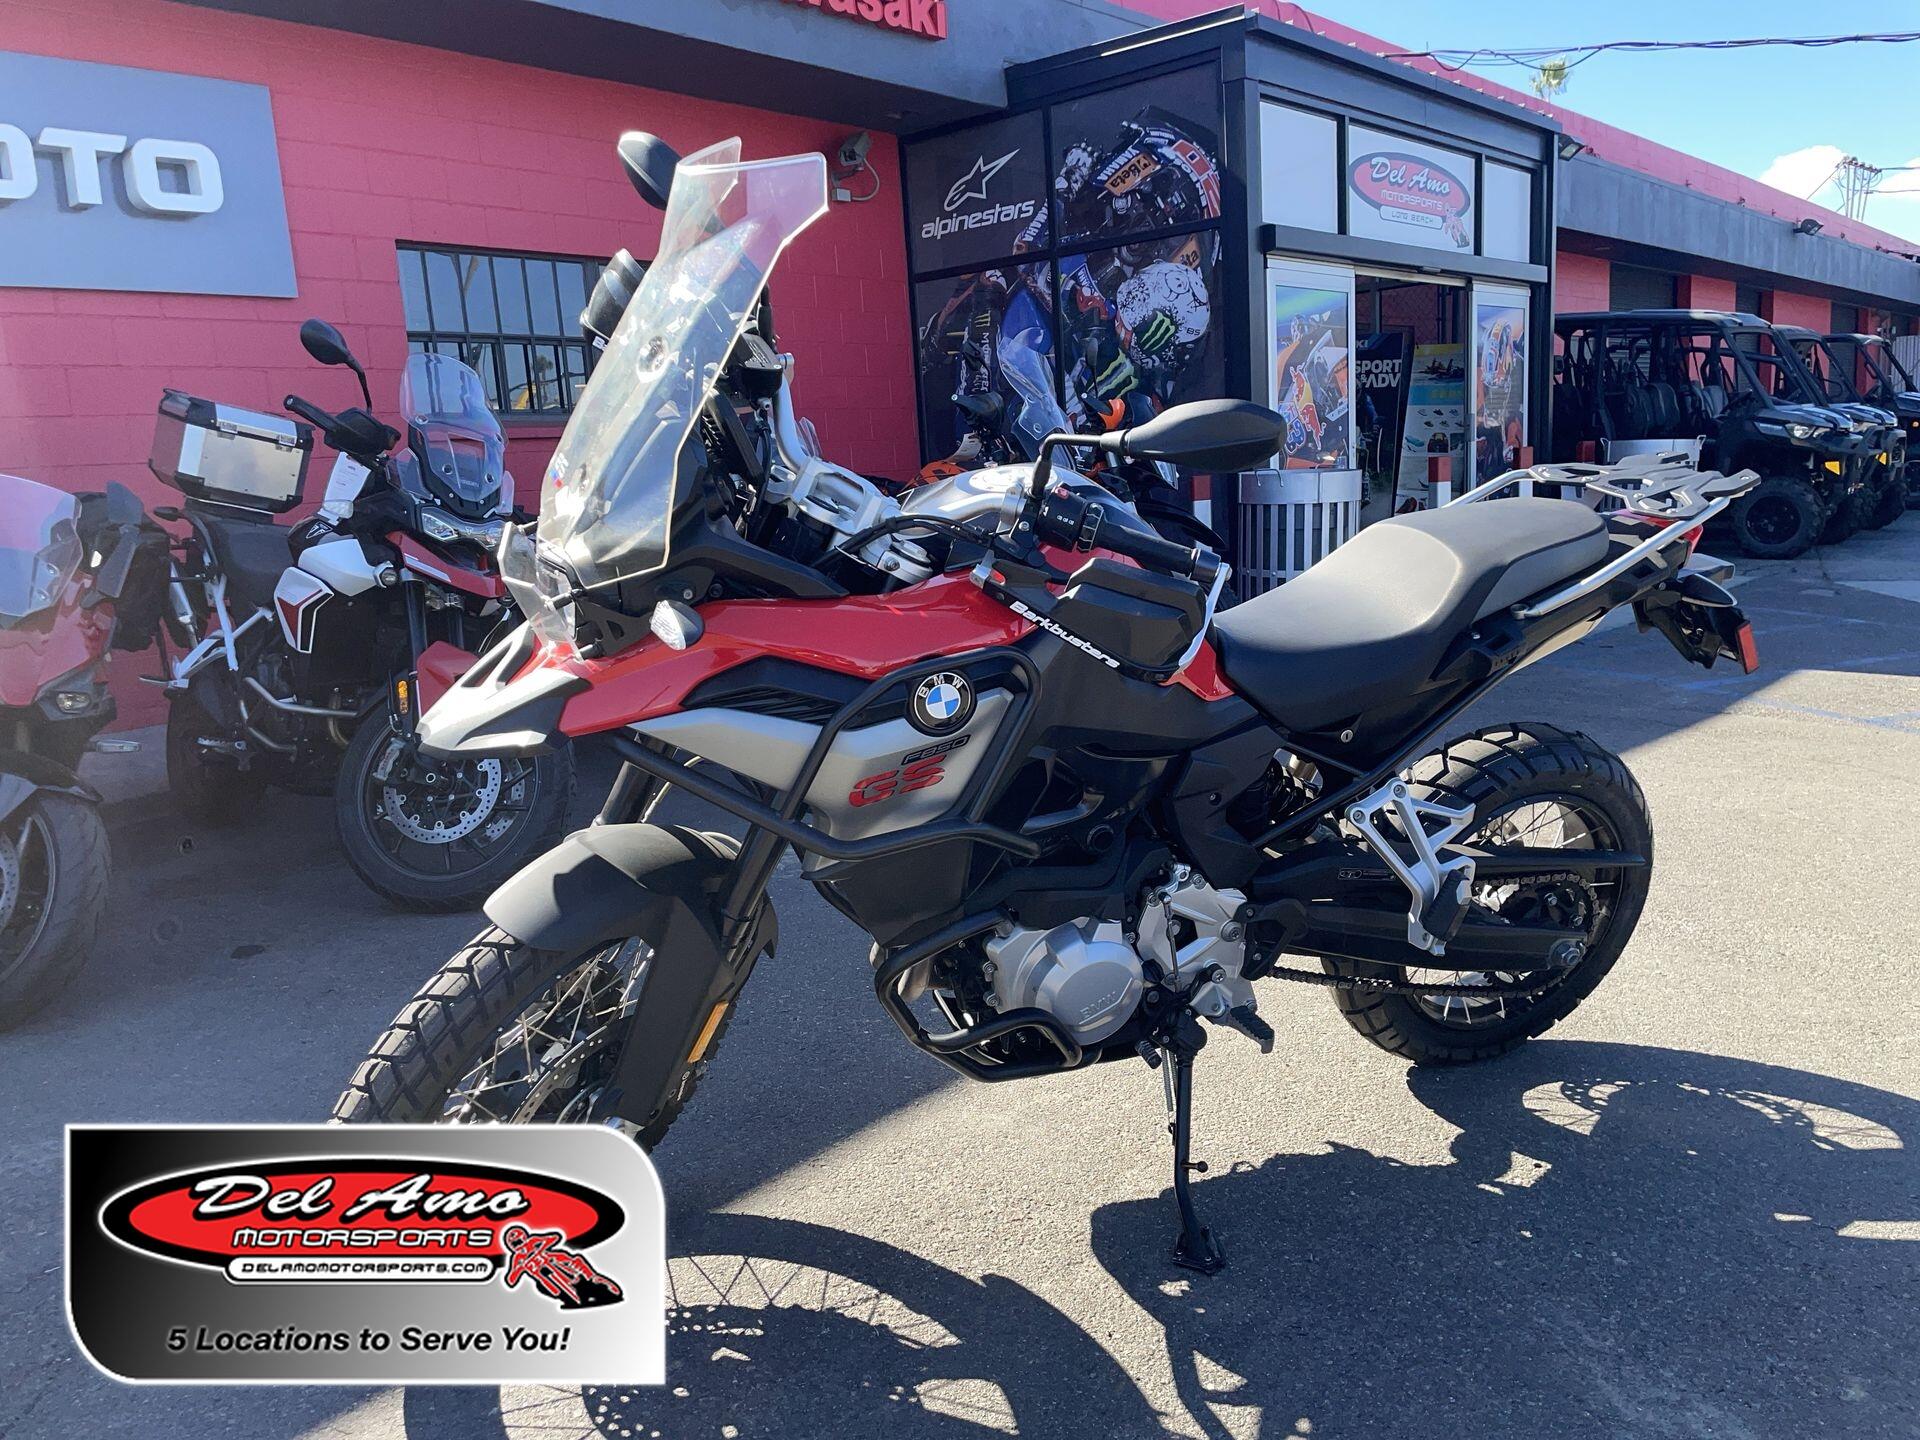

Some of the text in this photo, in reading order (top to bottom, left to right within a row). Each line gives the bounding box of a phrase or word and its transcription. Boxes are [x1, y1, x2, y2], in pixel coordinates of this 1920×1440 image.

[1371, 156, 1450, 194] Del Amo
[1381, 189, 1443, 210] MOTORSPORTS
[921, 200, 1035, 240] alpinestars
[1009, 600, 1120, 669] Barkbusters
[918, 673, 964, 698] BMW
[848, 753, 947, 808] GS
